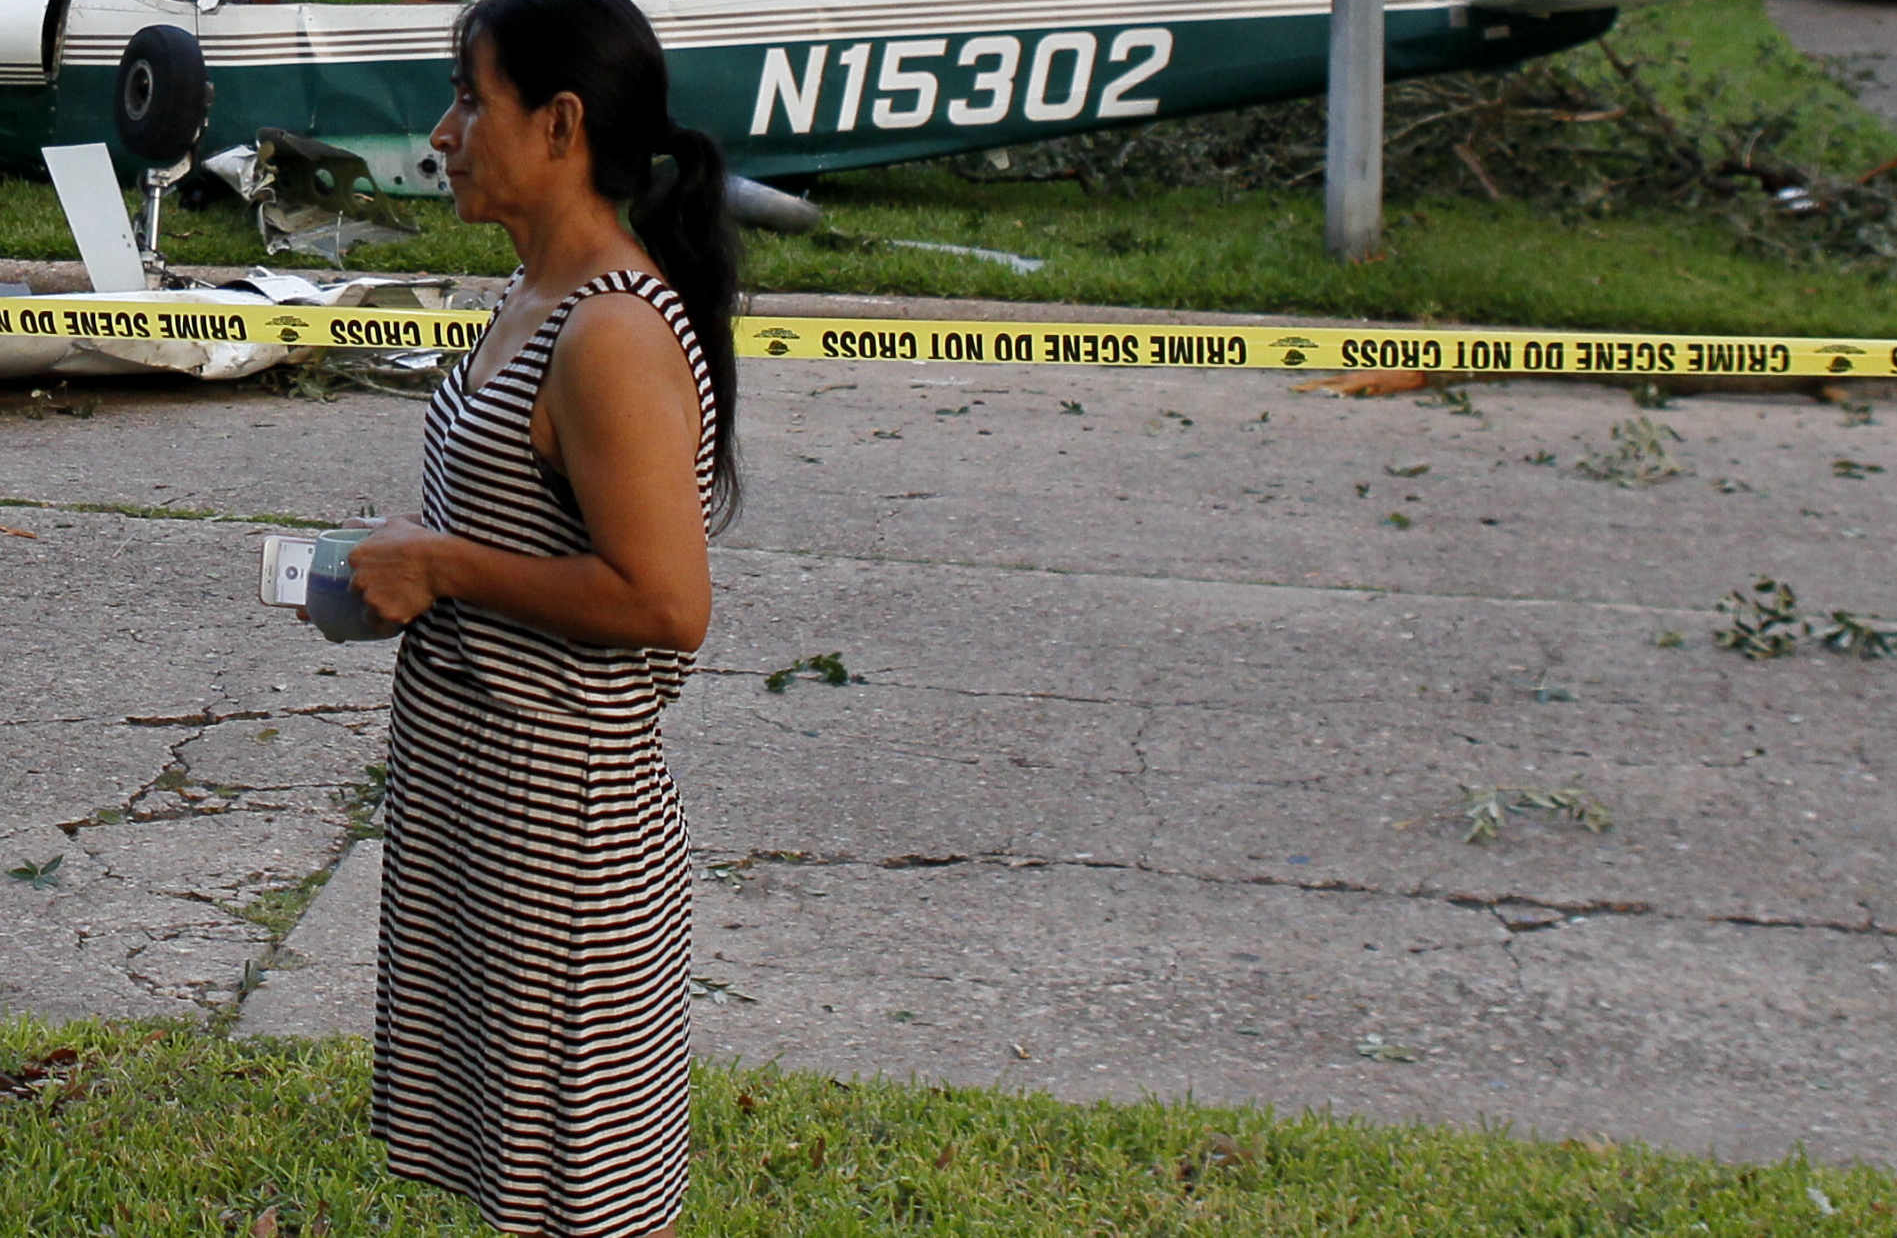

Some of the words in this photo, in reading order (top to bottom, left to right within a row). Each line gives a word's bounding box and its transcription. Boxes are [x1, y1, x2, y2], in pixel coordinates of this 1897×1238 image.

[749, 27, 1174, 136] N15302
[20, 309, 57, 335] DO
[64, 310, 152, 338] SCENE
[158, 313, 248, 341] CRIME
[330, 318, 421, 347] CROSS
[822, 330, 918, 360] CROSS
[928, 332, 984, 361] NOT
[994, 332, 1033, 362] DO
[1044, 333, 1140, 363] SCENE
[1150, 335, 1247, 365] CRIME
[1342, 339, 1442, 369] CROSS
[1452, 341, 1512, 370] NOT
[1523, 341, 1564, 371] DO
[1576, 342, 1676, 372] SCENE
[1687, 343, 1791, 373] CRIME
